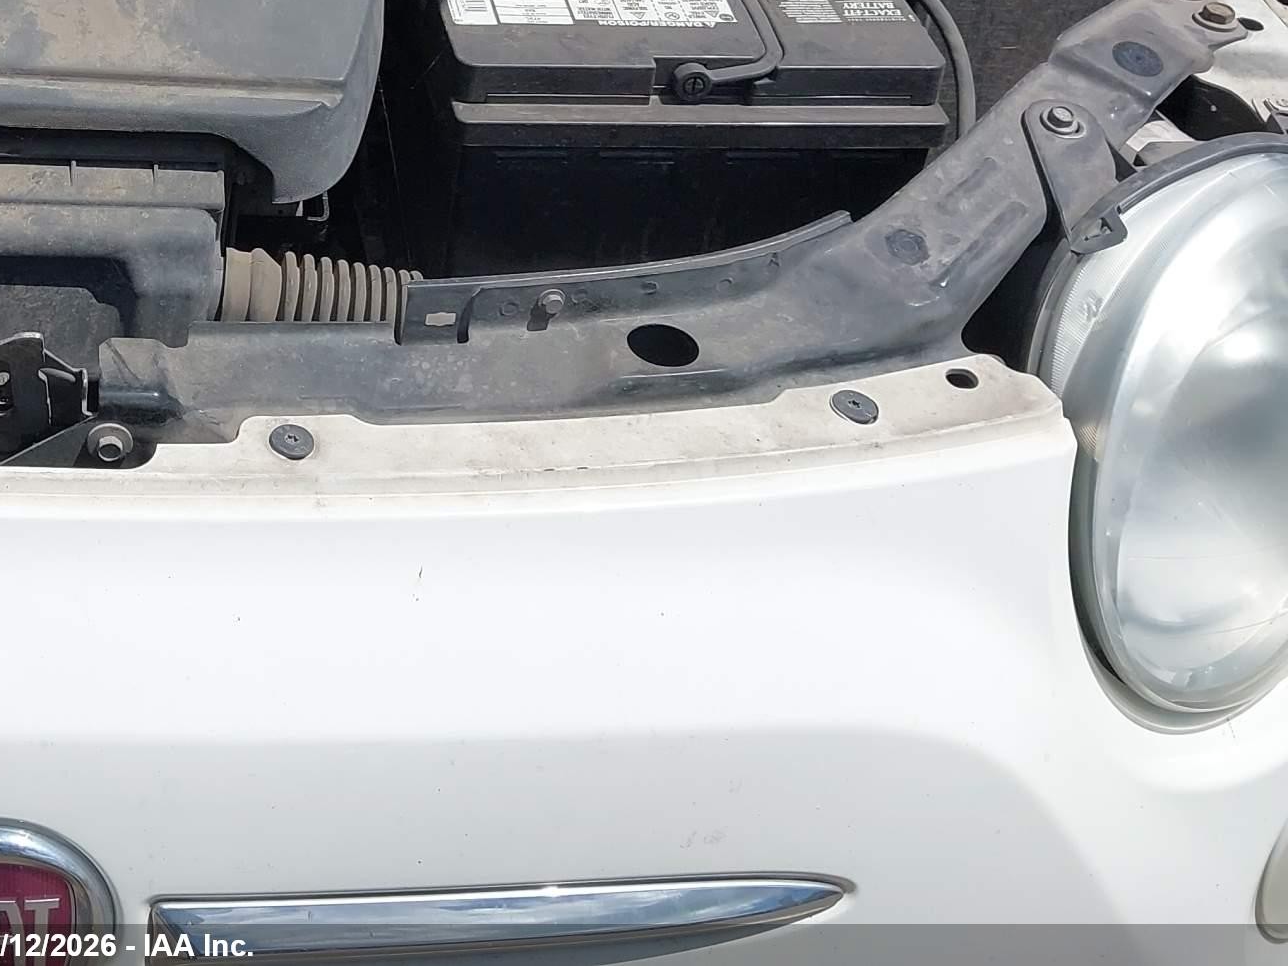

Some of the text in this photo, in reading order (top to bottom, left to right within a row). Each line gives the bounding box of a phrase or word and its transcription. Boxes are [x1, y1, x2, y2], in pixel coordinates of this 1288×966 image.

[843, 2, 895, 10] BATTERY
[843, 9, 902, 17] EXACT-FIT
[598, 20, 706, 28] DANGER/POISON
